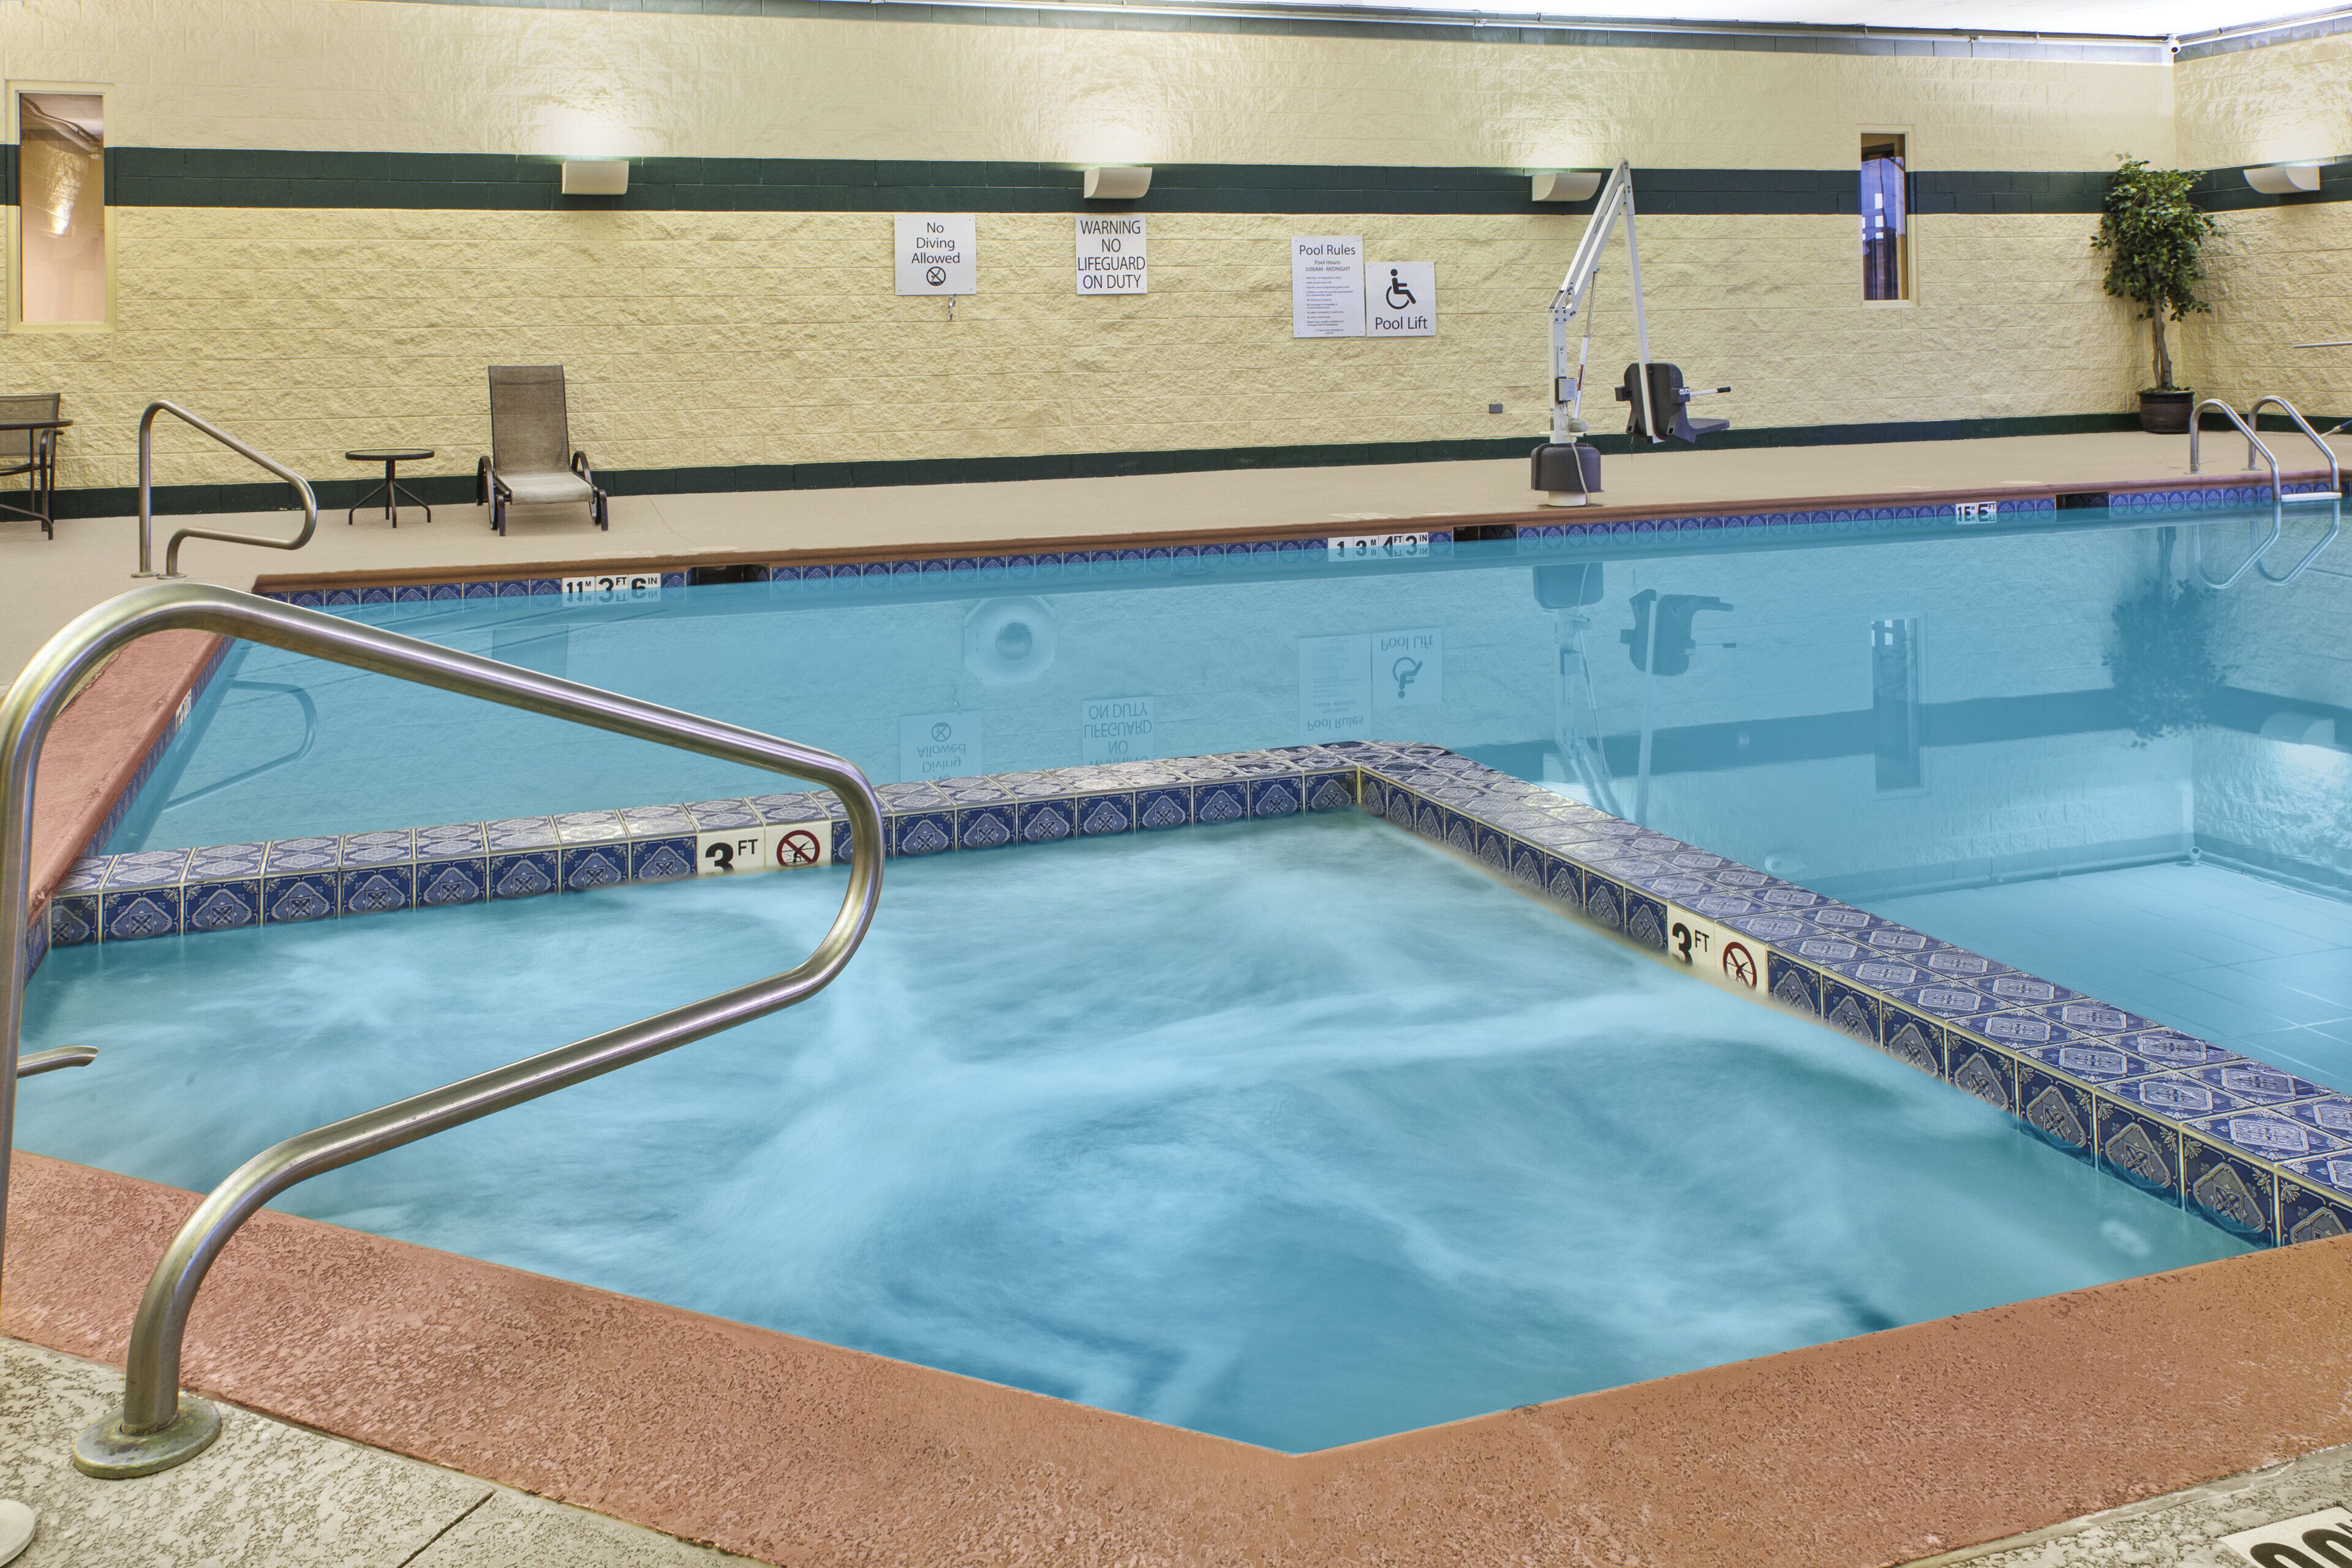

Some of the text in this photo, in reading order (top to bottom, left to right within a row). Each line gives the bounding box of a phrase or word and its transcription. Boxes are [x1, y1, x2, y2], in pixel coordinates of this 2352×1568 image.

[927, 222, 944, 233] No
[1080, 220, 1140, 235] WARNING
[916, 237, 955, 250] Diving
[1102, 238, 1121, 253] NO
[1300, 244, 1355, 255] Pool Rules
[911, 252, 960, 264] Allowed
[1077, 256, 1145, 271] LIFEGUARD
[1083, 274, 1141, 289] ON DUTY
[1376, 315, 1428, 330] Pool Lift
[705, 839, 758, 873] 3 FT
[1672, 922, 1709, 965] 3 FT
